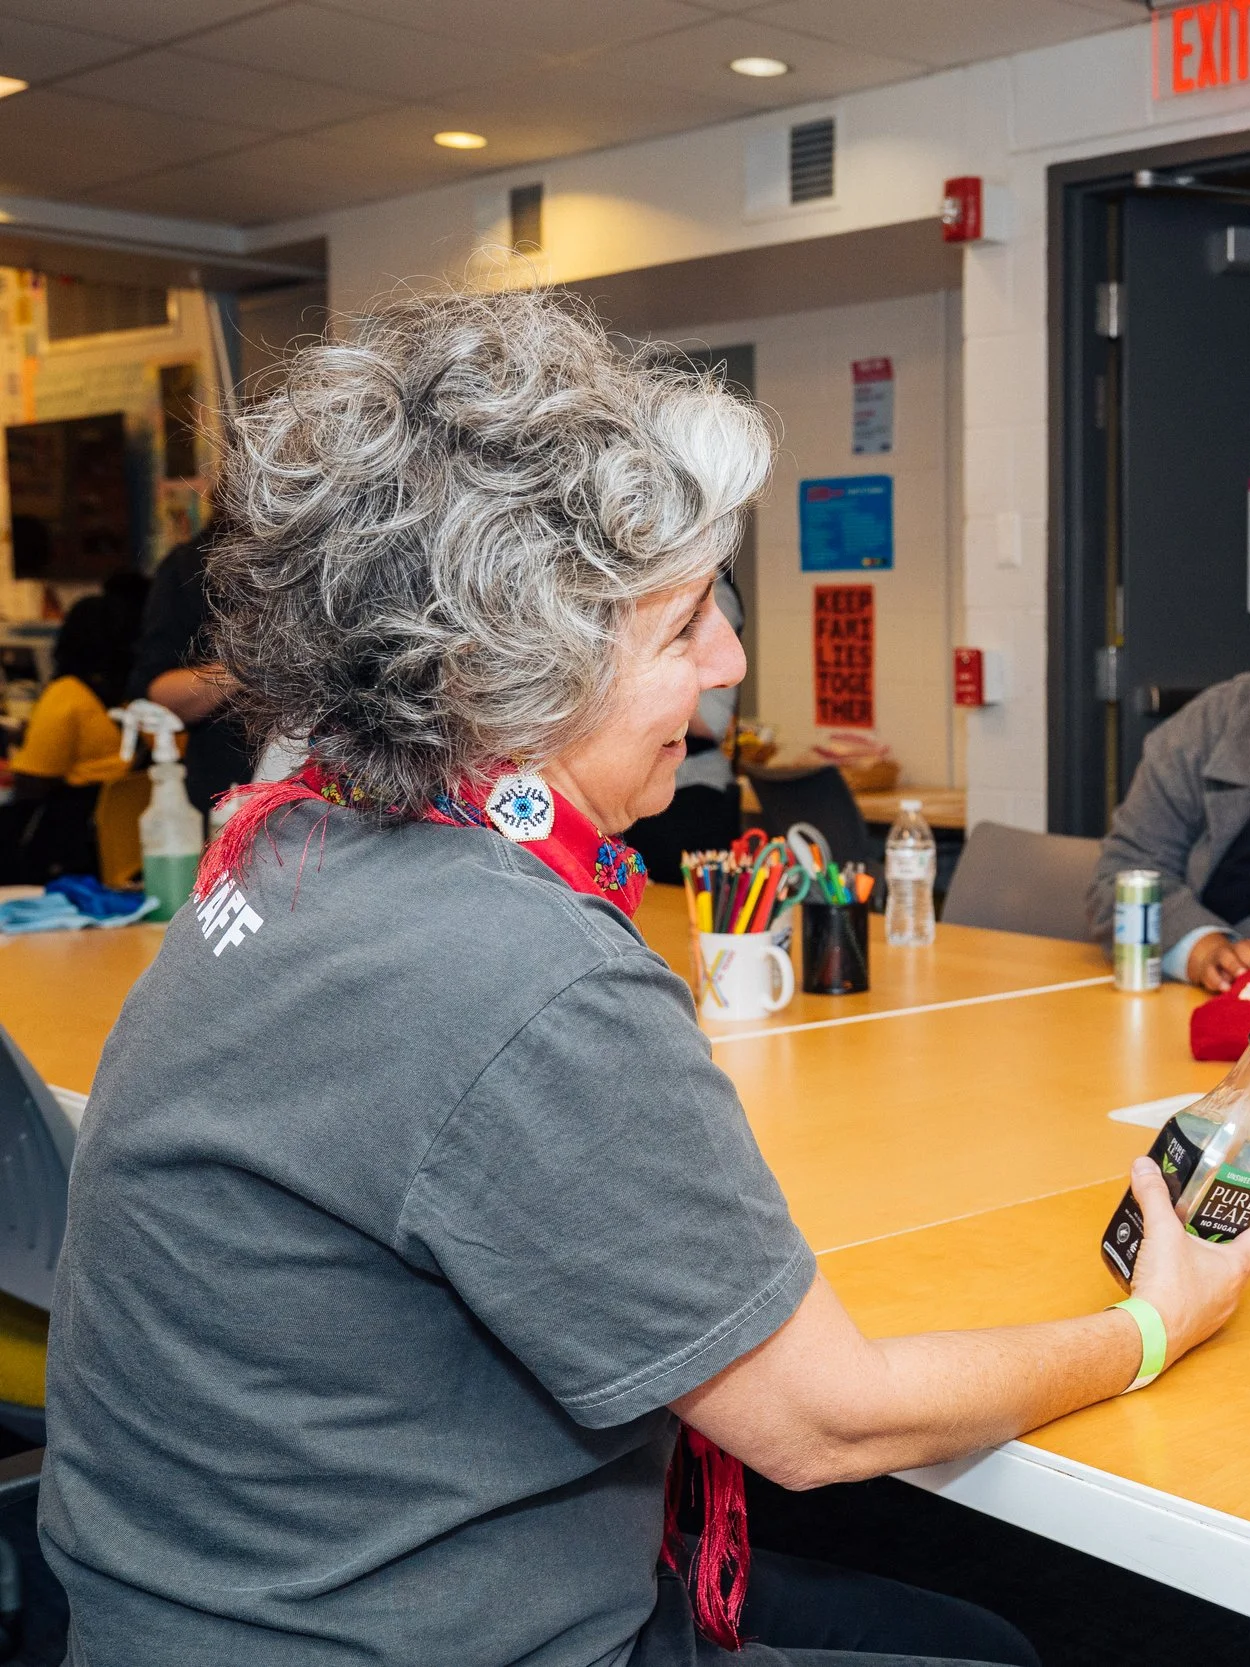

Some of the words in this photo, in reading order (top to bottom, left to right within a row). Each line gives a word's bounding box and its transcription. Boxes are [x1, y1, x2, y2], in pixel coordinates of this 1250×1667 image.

[816, 590, 873, 613] KEEP
[816, 644, 873, 667] LIES
[1167, 1144, 1183, 1165] LEAF
[1171, 1137, 1186, 1156] PURE
[1200, 1220, 1213, 1228] NO
[1212, 1222, 1238, 1234] SUGAR
